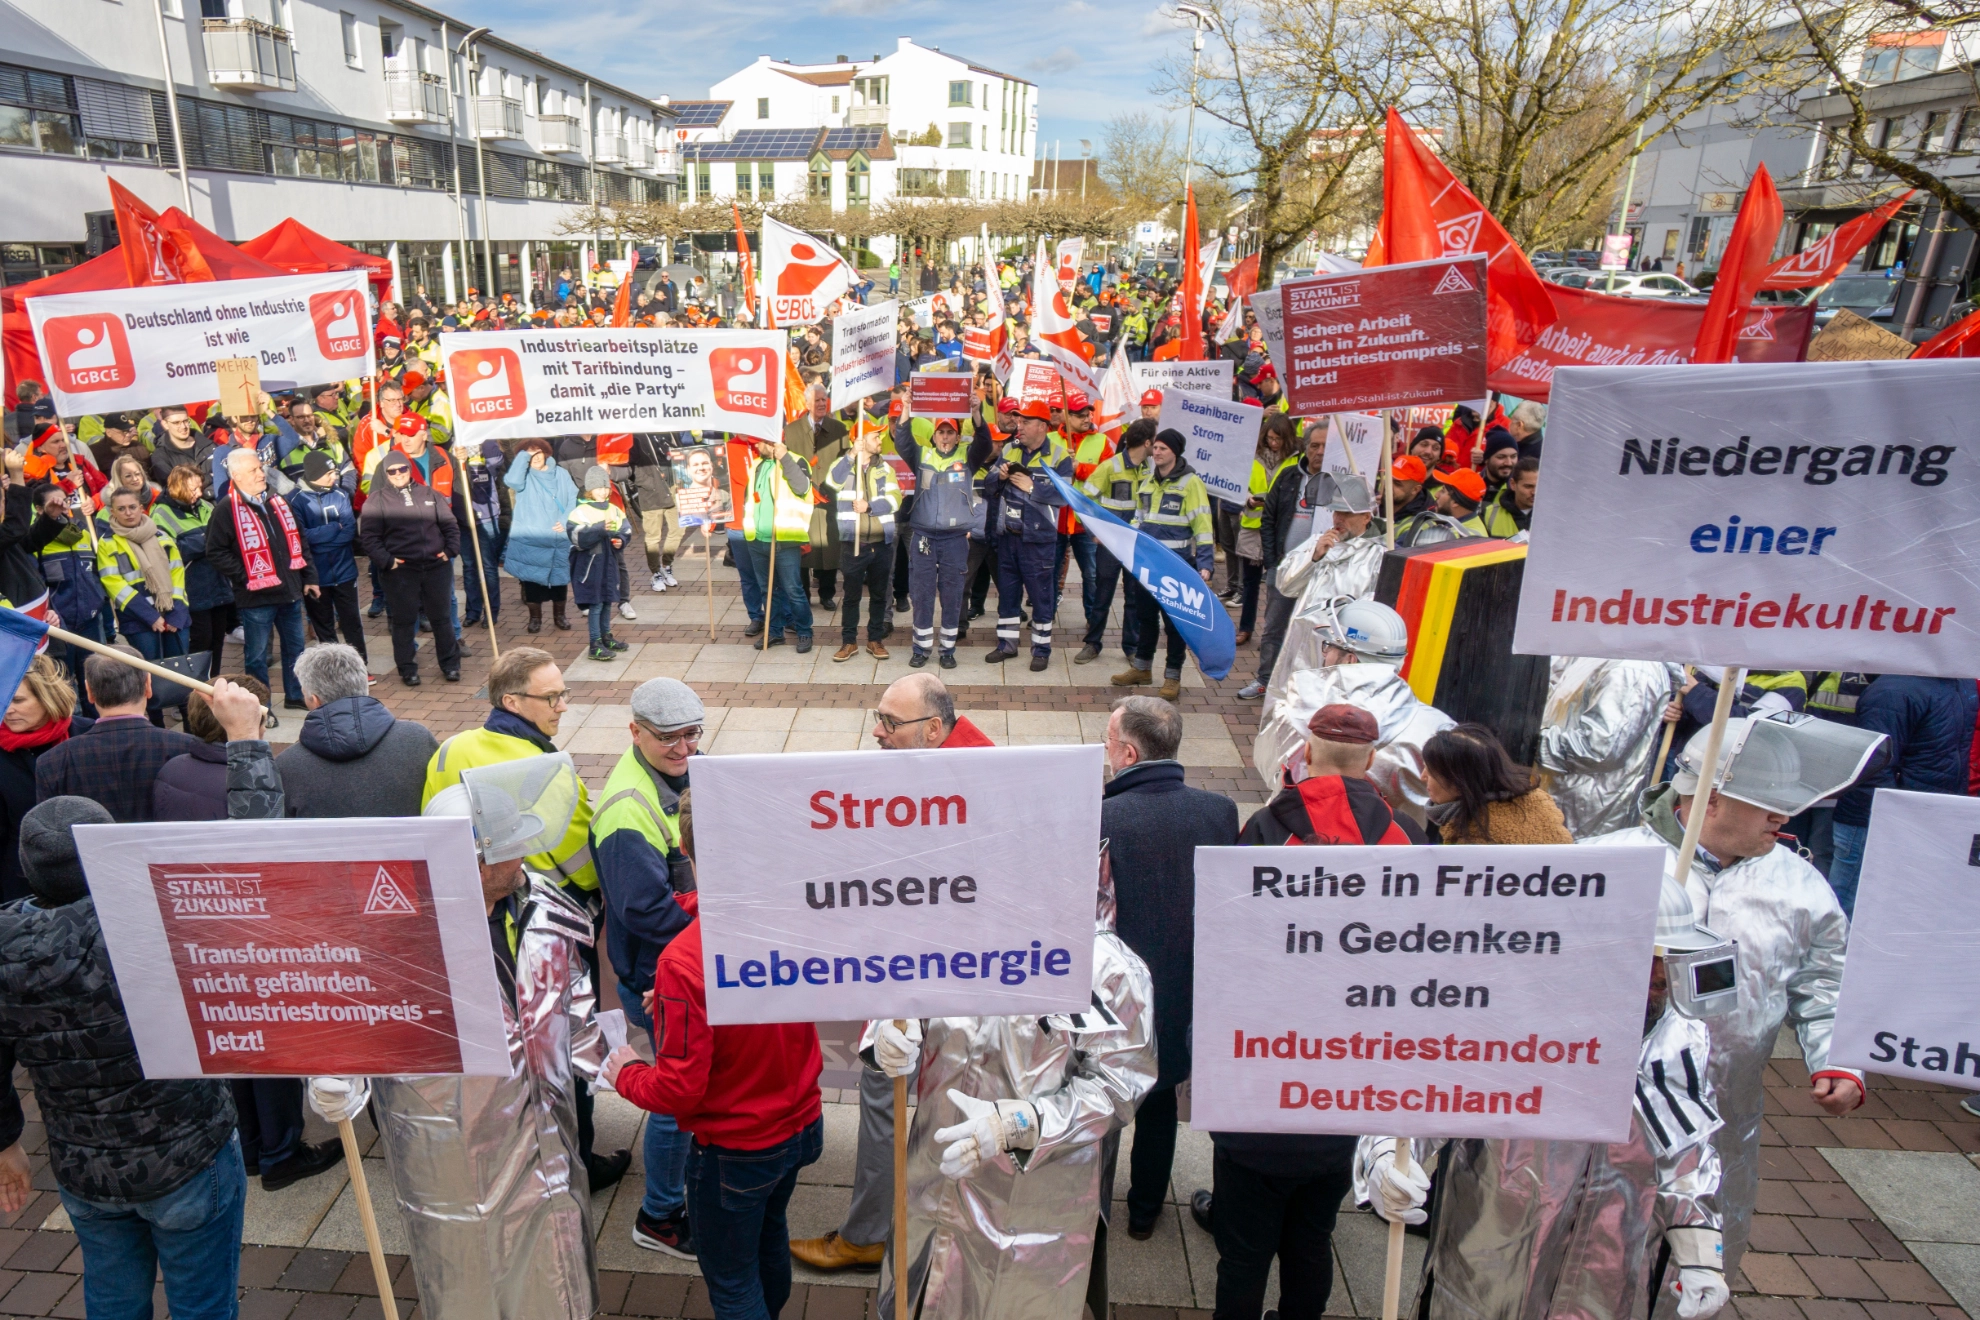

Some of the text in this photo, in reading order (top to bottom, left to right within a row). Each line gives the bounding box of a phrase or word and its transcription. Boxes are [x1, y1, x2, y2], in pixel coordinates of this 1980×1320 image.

[903, 297, 927, 308] eute
[1290, 285, 1360, 301] STAHL IST
[1290, 294, 1361, 311] ZUKUNFT
[125, 298, 306, 330] Deutschland ohne Industrie
[1834, 311, 1871, 337] HERR
[204, 328, 250, 347] ist wie
[842, 315, 889, 338] Transformation
[1293, 314, 1412, 339] Sichere Arbeit
[329, 339, 361, 353] IGBCE
[520, 339, 698, 357] Industriearbeitsplätze
[840, 342, 857, 356] nicht
[1294, 329, 1430, 354] auch in Zukunft.
[1536, 326, 1592, 360] Arbeit
[166, 361, 217, 378] Somme
[261, 349, 286, 366] Deo
[834, 346, 894, 376] Industriestrompreis
[1294, 342, 1463, 371] Industriestrompreis
[70, 368, 120, 385] IGBCE
[542, 361, 569, 376] mit
[571, 360, 673, 379] Tarifbindung
[845, 366, 883, 388] bereitstellen
[1141, 367, 1221, 377] Für eine Aktive
[1295, 371, 1338, 389] Jetzt!
[550, 384, 595, 399] damit
[1149, 381, 1212, 391] und Sichere
[470, 398, 513, 415] IGBCE
[728, 393, 768, 409] IGBCE
[1296, 388, 1444, 410] igmetall.de/Stahl-ist-Zukunft
[536, 402, 706, 424] bezahlt werden kann!
[1181, 399, 1245, 425] Bezahlbarer
[1192, 425, 1224, 443] Strom
[1345, 421, 1368, 444] Wir
[1196, 448, 1212, 462] für
[1619, 435, 1957, 487] Niedergang
[1195, 473, 1242, 493] oduktion
[1689, 515, 1837, 556] einer
[1140, 567, 1205, 609] LSW
[1551, 589, 1956, 634] Industriekultur
[809, 790, 967, 830] Strom
[167, 880, 263, 896] STAHL IST
[805, 874, 978, 910] unsere
[1253, 865, 1606, 897] Ruhe in Frieden
[172, 898, 267, 913] ZUKUNFT
[1286, 921, 1561, 955] in Gedenken
[183, 942, 361, 964] Transformation
[715, 940, 1072, 989] Lebensenergie
[193, 971, 377, 998] nicht gefährden.
[1345, 979, 1490, 1008] an den
[200, 1000, 423, 1026] Industriestrompreis
[207, 1030, 265, 1055] Jetzt!
[1233, 1029, 1602, 1065] Industriestandort
[1869, 1031, 1980, 1078] Stah
[1279, 1081, 1543, 1114] Deutschland
